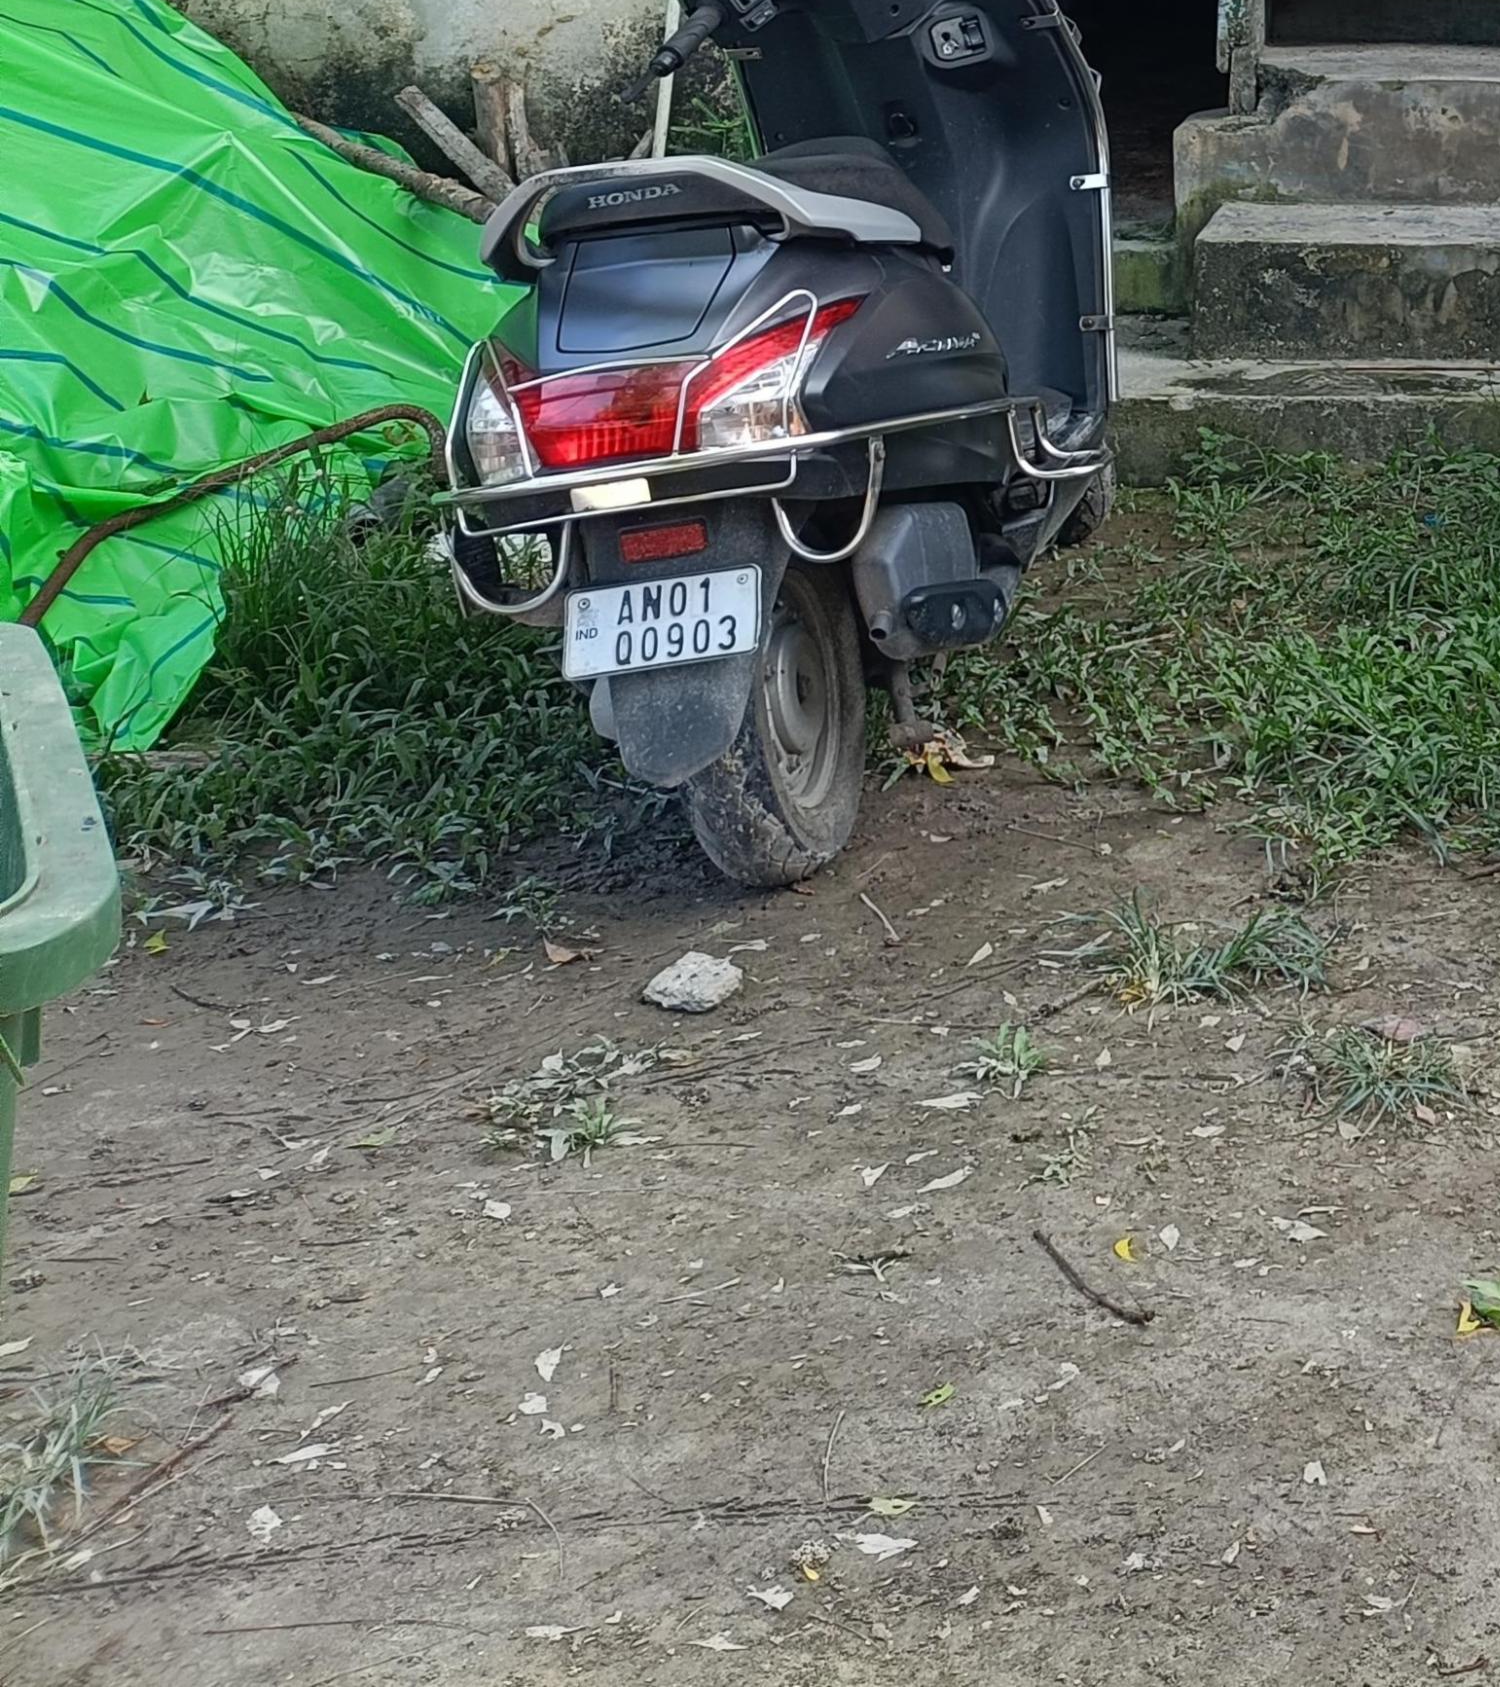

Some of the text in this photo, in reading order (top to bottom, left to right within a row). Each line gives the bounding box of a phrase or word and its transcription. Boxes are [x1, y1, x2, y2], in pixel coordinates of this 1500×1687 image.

[587, 183, 683, 209] HONDA
[616, 576, 711, 626] AN01
[575, 627, 598, 640] IND
